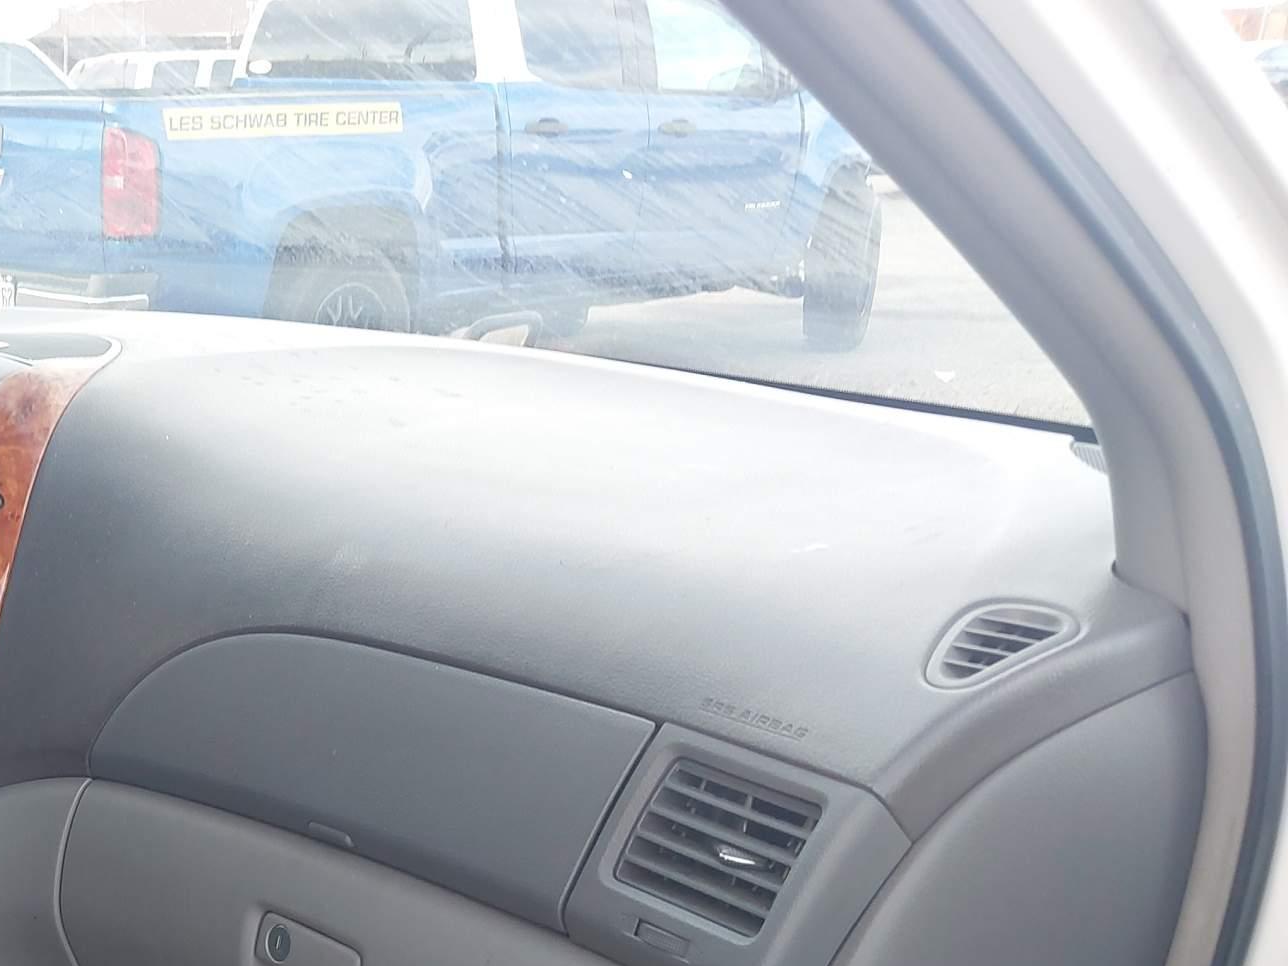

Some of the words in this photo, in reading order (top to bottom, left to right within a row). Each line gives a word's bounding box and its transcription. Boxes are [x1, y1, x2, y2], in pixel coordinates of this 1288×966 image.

[168, 115, 203, 132] LES
[210, 112, 288, 131] SCHWAB
[294, 111, 329, 128] TIRE
[335, 110, 400, 127] CENTER
[740, 709, 810, 739] AIRBAG
